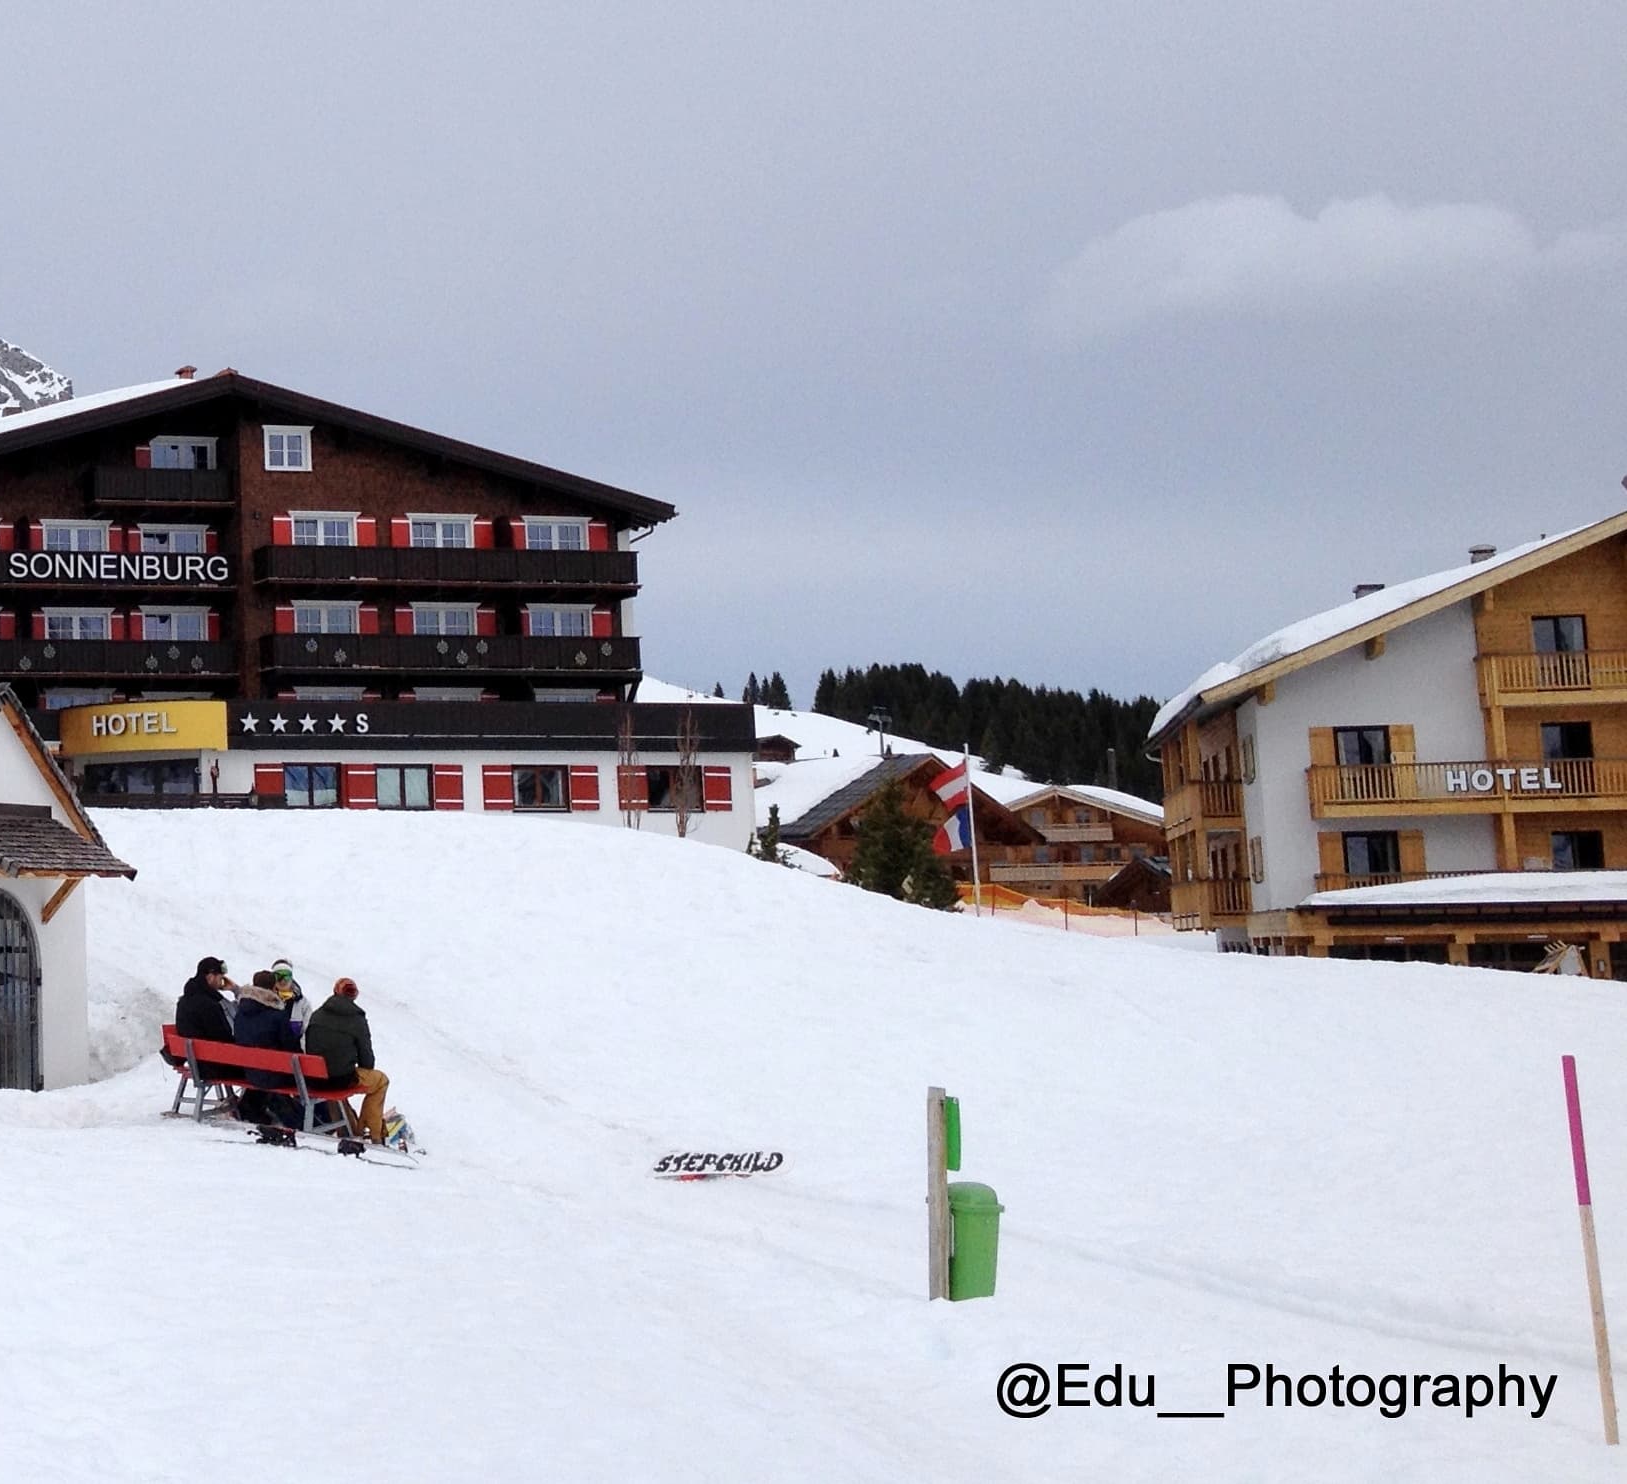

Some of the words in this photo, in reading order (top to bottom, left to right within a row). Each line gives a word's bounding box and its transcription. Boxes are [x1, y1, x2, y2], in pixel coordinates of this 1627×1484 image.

[9, 552, 228, 581] SONNENBURG
[92, 712, 177, 737] HOTEL
[356, 713, 369, 733] S
[1446, 767, 1562, 792] HOTEL
[653, 1151, 784, 1173] STEPCHILD
